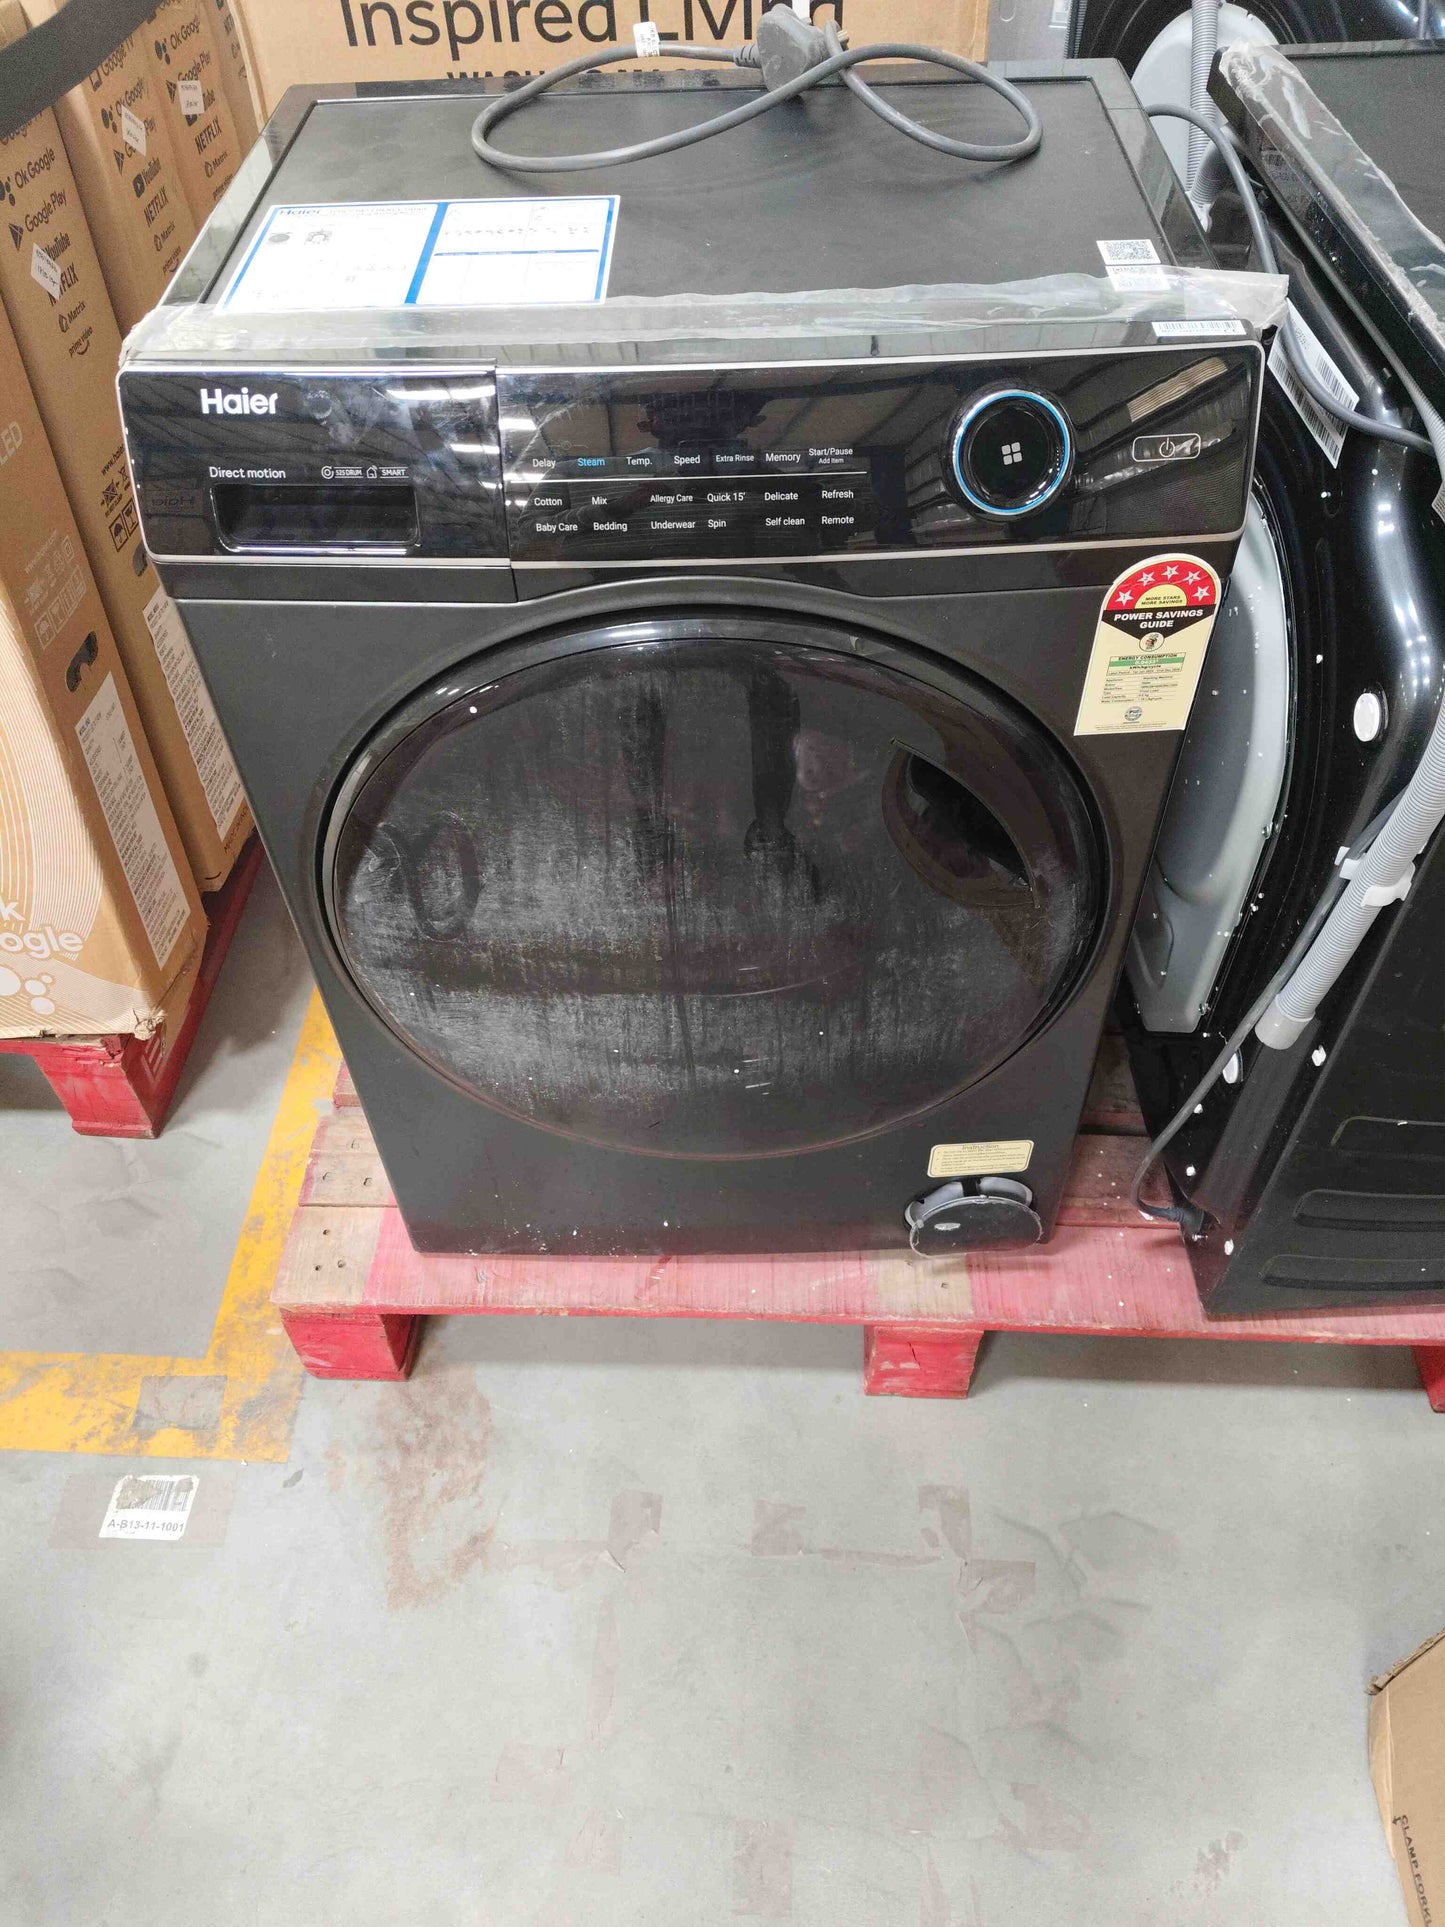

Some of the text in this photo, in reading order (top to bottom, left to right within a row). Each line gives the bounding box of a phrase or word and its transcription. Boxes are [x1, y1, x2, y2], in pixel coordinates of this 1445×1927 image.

[340, 0, 618, 61] Inspired
[194, 115, 222, 155] NETFLIX
[14, 148, 55, 189] Ok Google
[25, 189, 67, 232] Google Play
[144, 186, 169, 228] NETFLIX
[67, 301, 86, 324] Matrix
[69, 326, 93, 358] prime video
[200, 386, 279, 414] Haier
[808, 447, 853, 456] Start/Pause
[577, 457, 606, 467] Steam
[626, 456, 653, 467] Temp.
[674, 455, 701, 466] Speed
[715, 454, 755, 462] Extra Rinse
[765, 453, 801, 463] Memory
[532, 458, 556, 469] Delay
[209, 466, 286, 479] Direct motion
[381, 468, 406, 476] SMART
[650, 494, 693, 504] Allergy Care
[707, 492, 746, 502] Quick 15'
[764, 491, 799, 500] Delicate
[821, 490, 854, 499] Refresh
[534, 497, 563, 506] Cotton
[591, 496, 608, 505] Mix
[650, 520, 696, 530] Underwear
[708, 519, 727, 529] Spin
[765, 517, 805, 526] Self clean
[821, 516, 854, 525] Remote
[536, 522, 578, 533] Baby Care
[593, 522, 628, 532] Bedding
[1113, 609, 1204, 621] POWER SAVINGS
[1139, 620, 1174, 629] GUIDE
[107, 1519, 185, 1532] A-B13-11-1001
[1401, 1815, 1419, 1869] CLAMP
